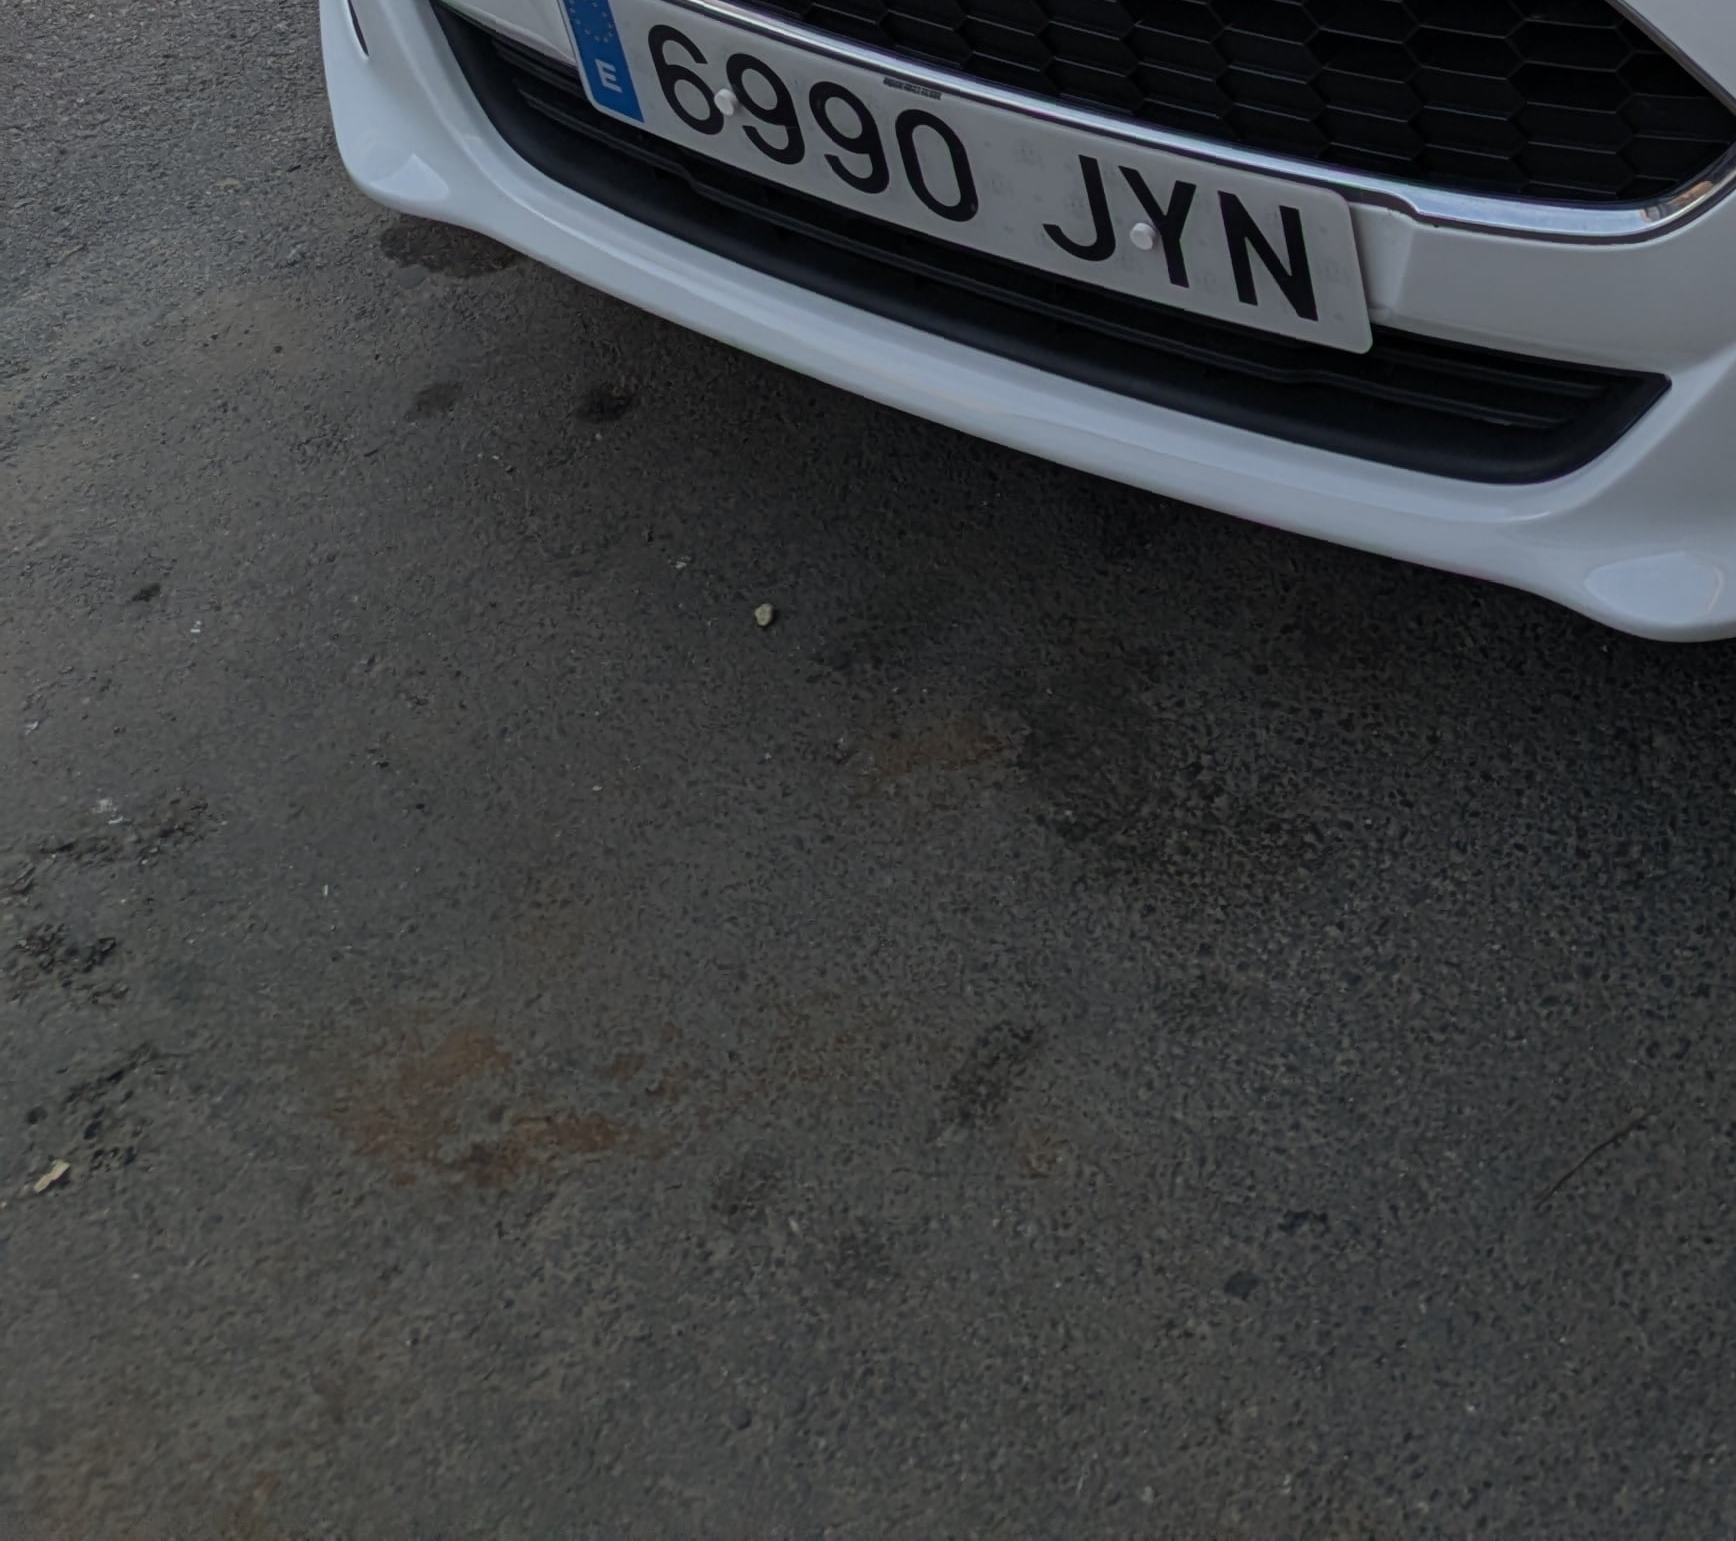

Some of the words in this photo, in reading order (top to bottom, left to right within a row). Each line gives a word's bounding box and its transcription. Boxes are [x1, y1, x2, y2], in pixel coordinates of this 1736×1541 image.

[595, 58, 623, 94] E
[648, 24, 978, 223] 6990
[1043, 154, 1319, 322] JYN
